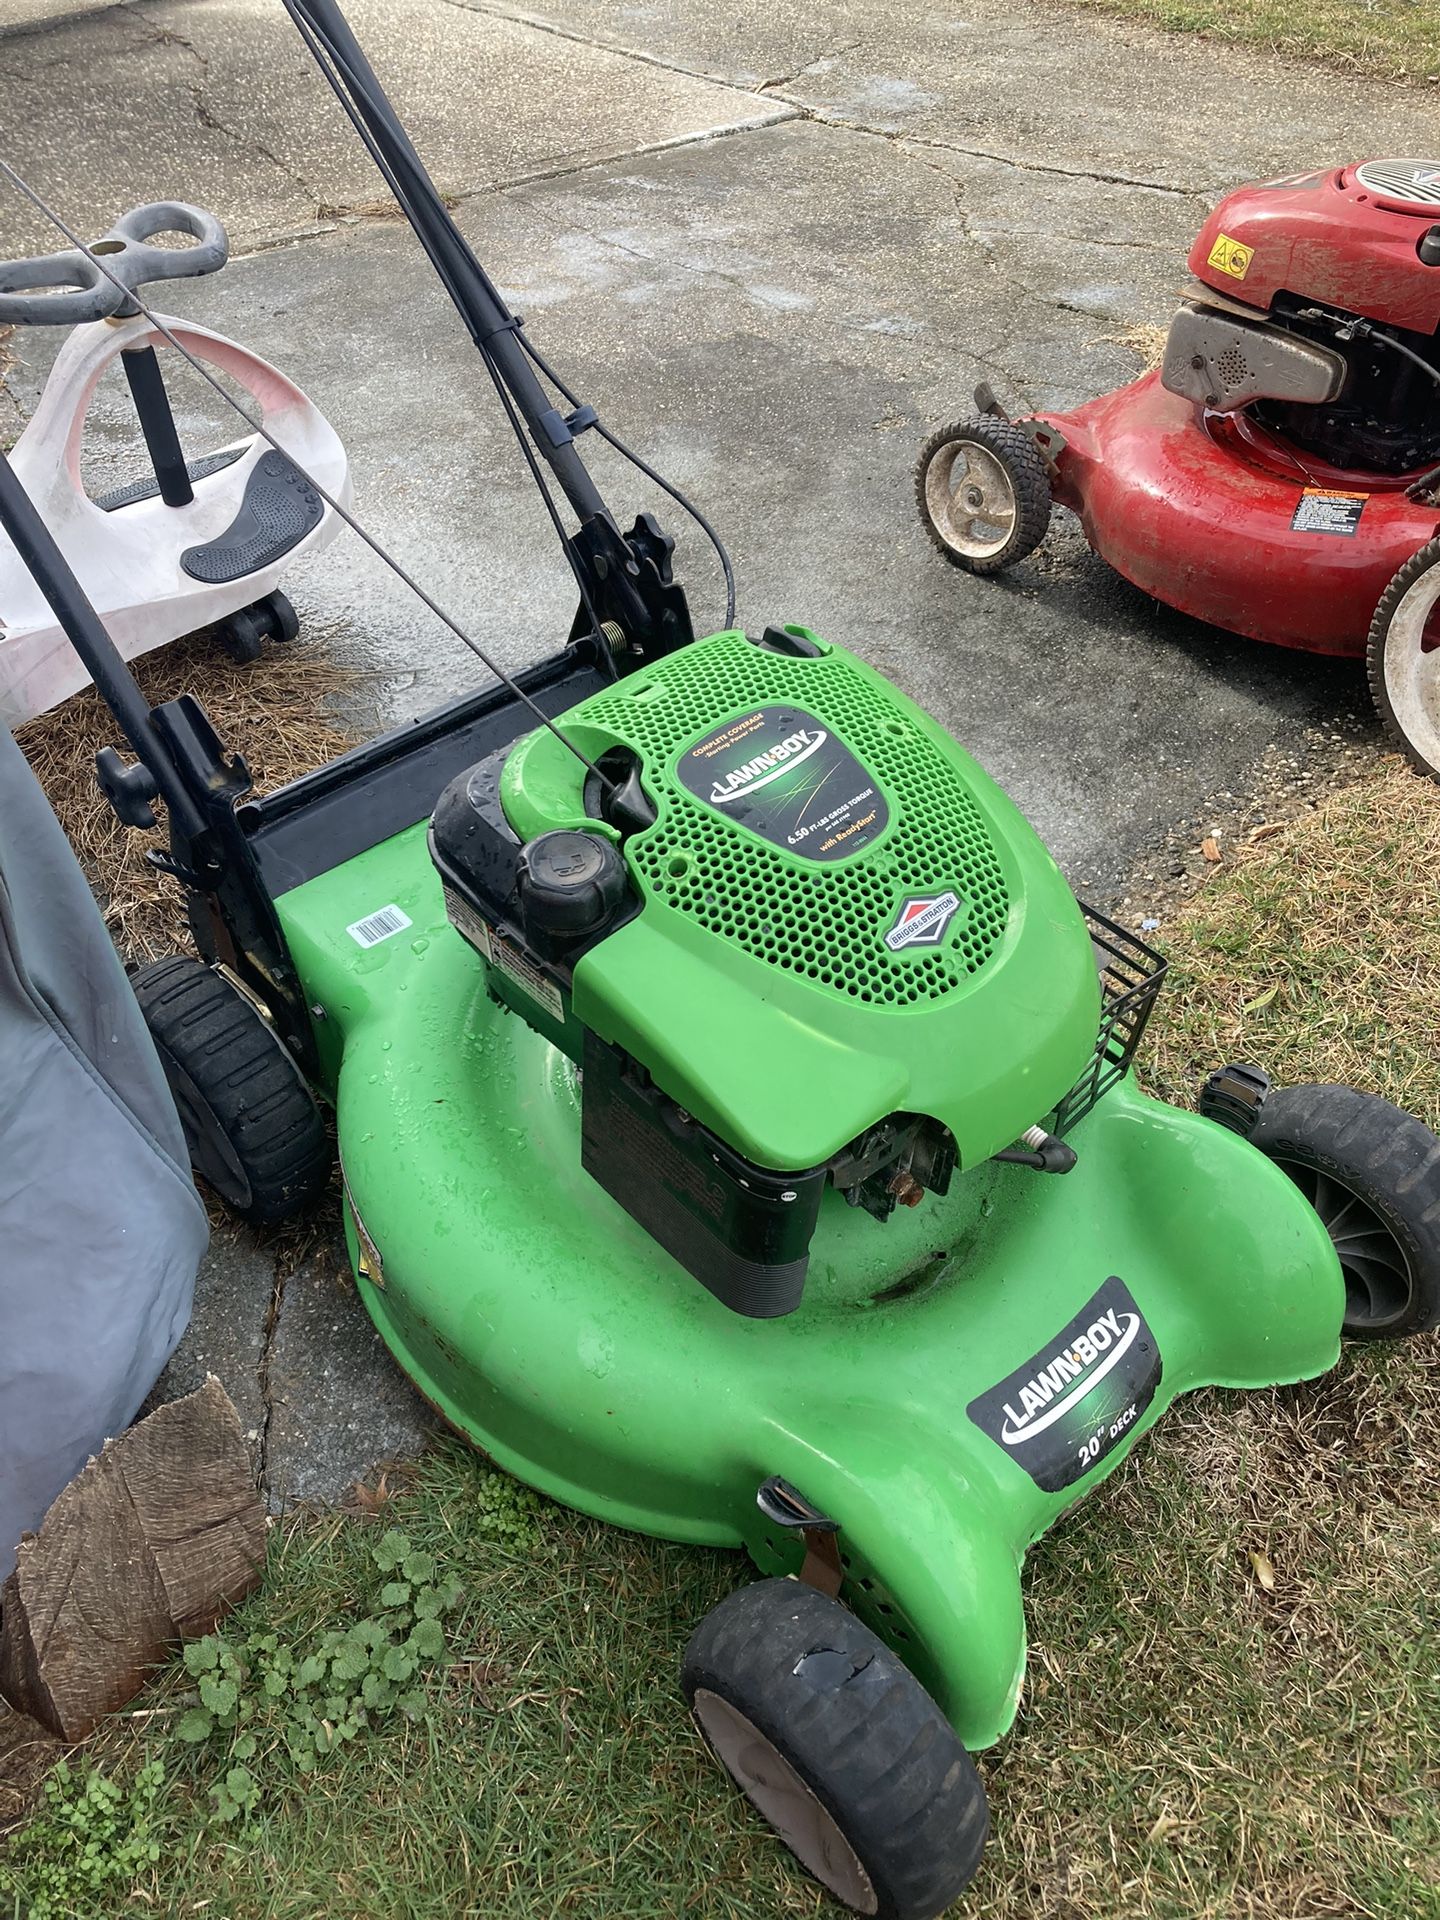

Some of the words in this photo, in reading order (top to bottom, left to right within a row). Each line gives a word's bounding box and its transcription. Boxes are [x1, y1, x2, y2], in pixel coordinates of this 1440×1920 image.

[692, 734, 728, 757] COMPLETE
[728, 713, 764, 736] COVERAGE
[787, 827, 810, 844] 6.50
[809, 816, 830, 832] FT-LBS
[828, 803, 850, 819] GROSS
[848, 788, 874, 807] TORQUE
[819, 837, 838, 852] with
[1078, 1425, 1105, 1467] 20"
[1109, 1403, 1138, 1439] DECK
